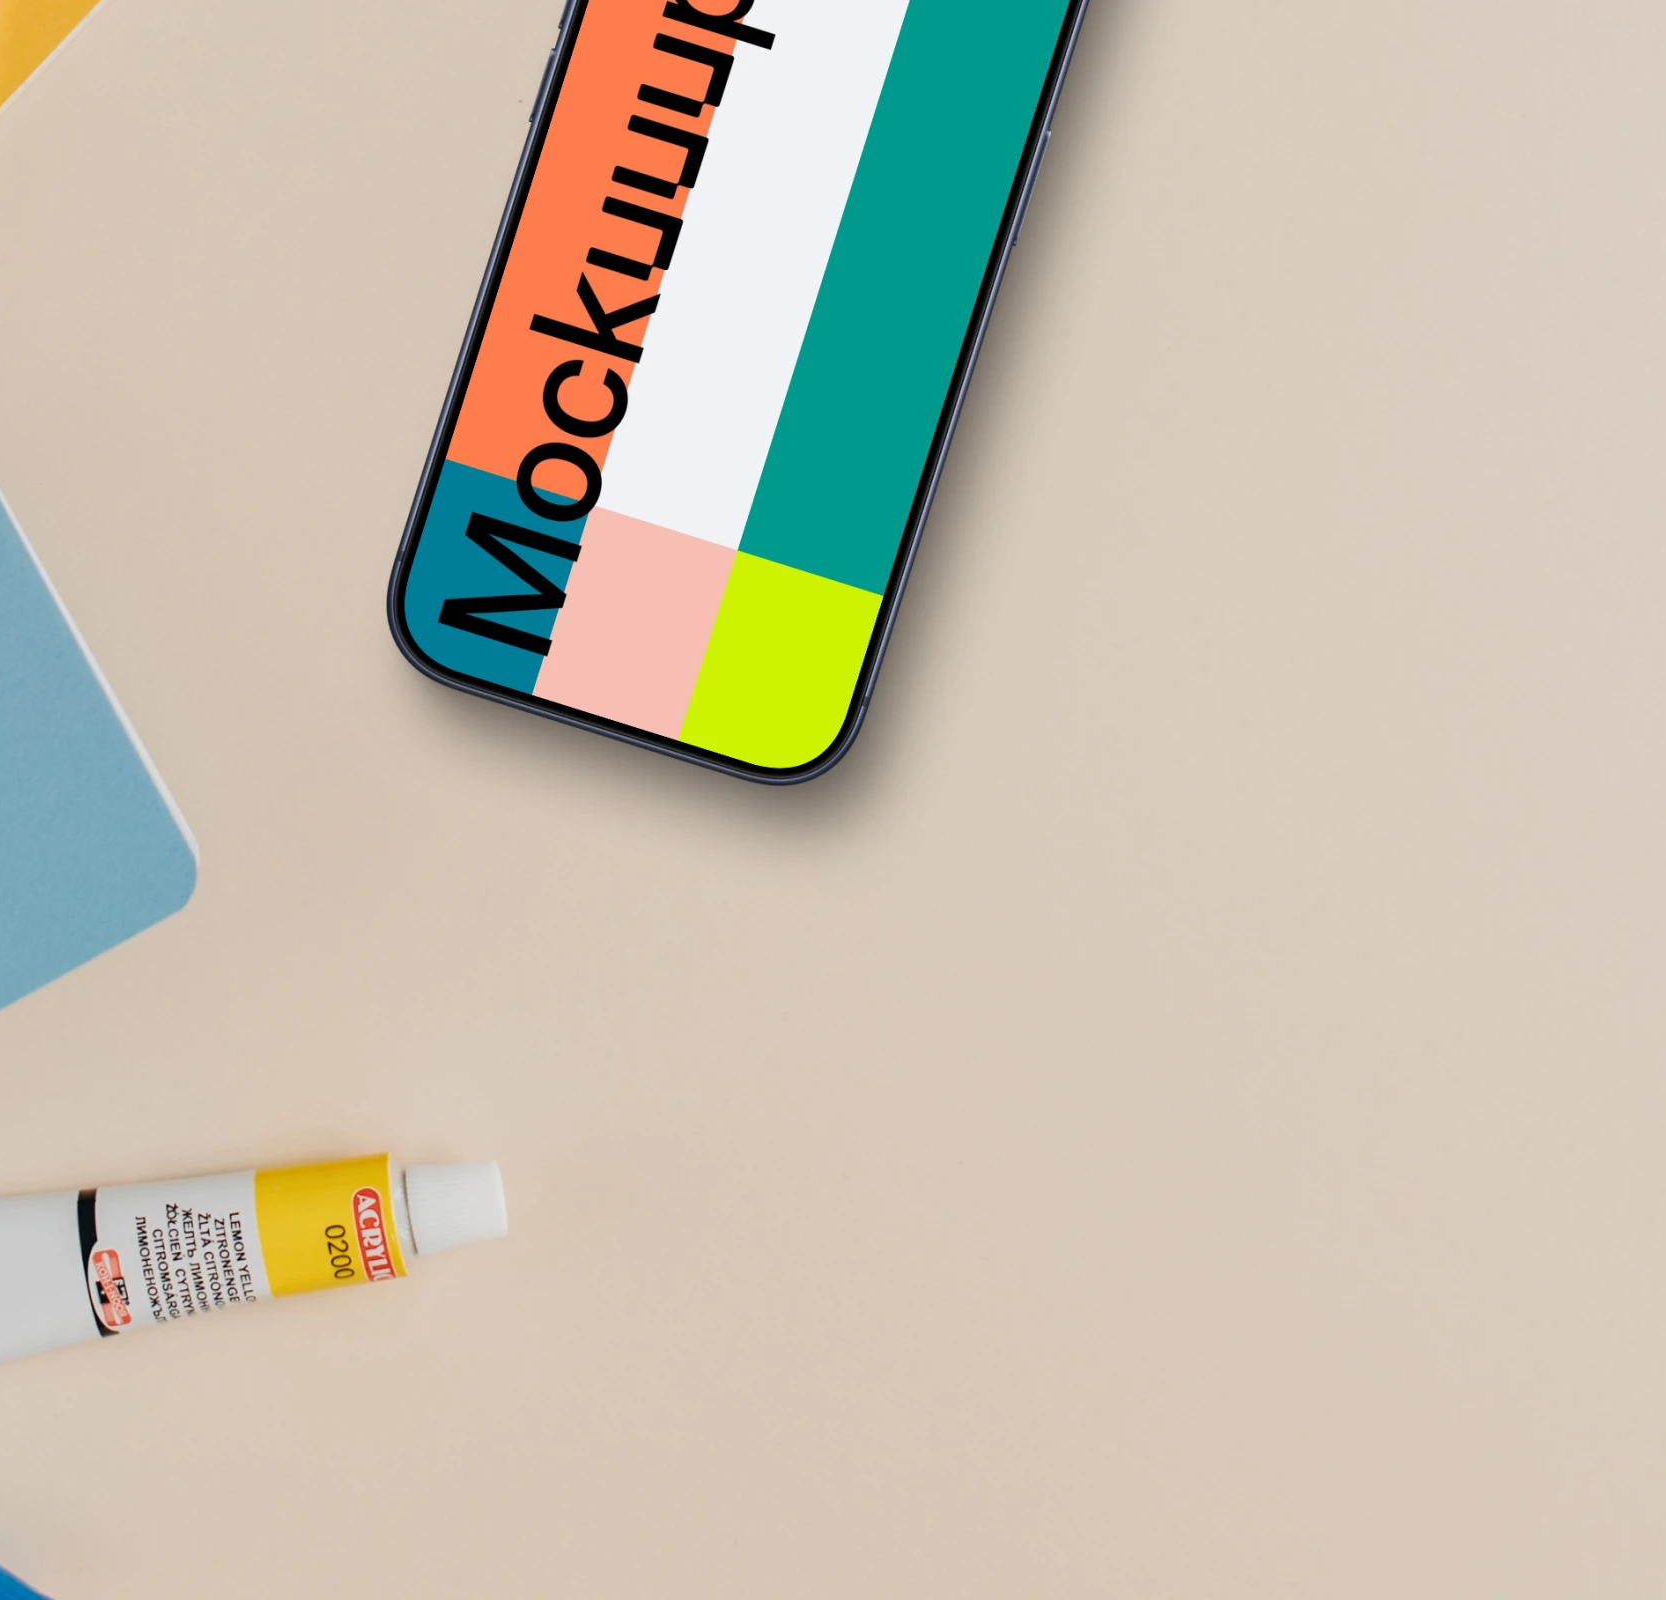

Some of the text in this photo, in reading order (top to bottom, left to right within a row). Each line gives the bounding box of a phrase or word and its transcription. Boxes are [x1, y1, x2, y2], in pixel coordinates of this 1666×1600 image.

[181, 1208, 198, 1258] ЖЕЛТЬ
[197, 1211, 214, 1248] ŽLTÁ
[228, 1211, 247, 1262] LEMON
[325, 1224, 355, 1279] 0200
[94, 1260, 129, 1318] KOH-I-NOOR
